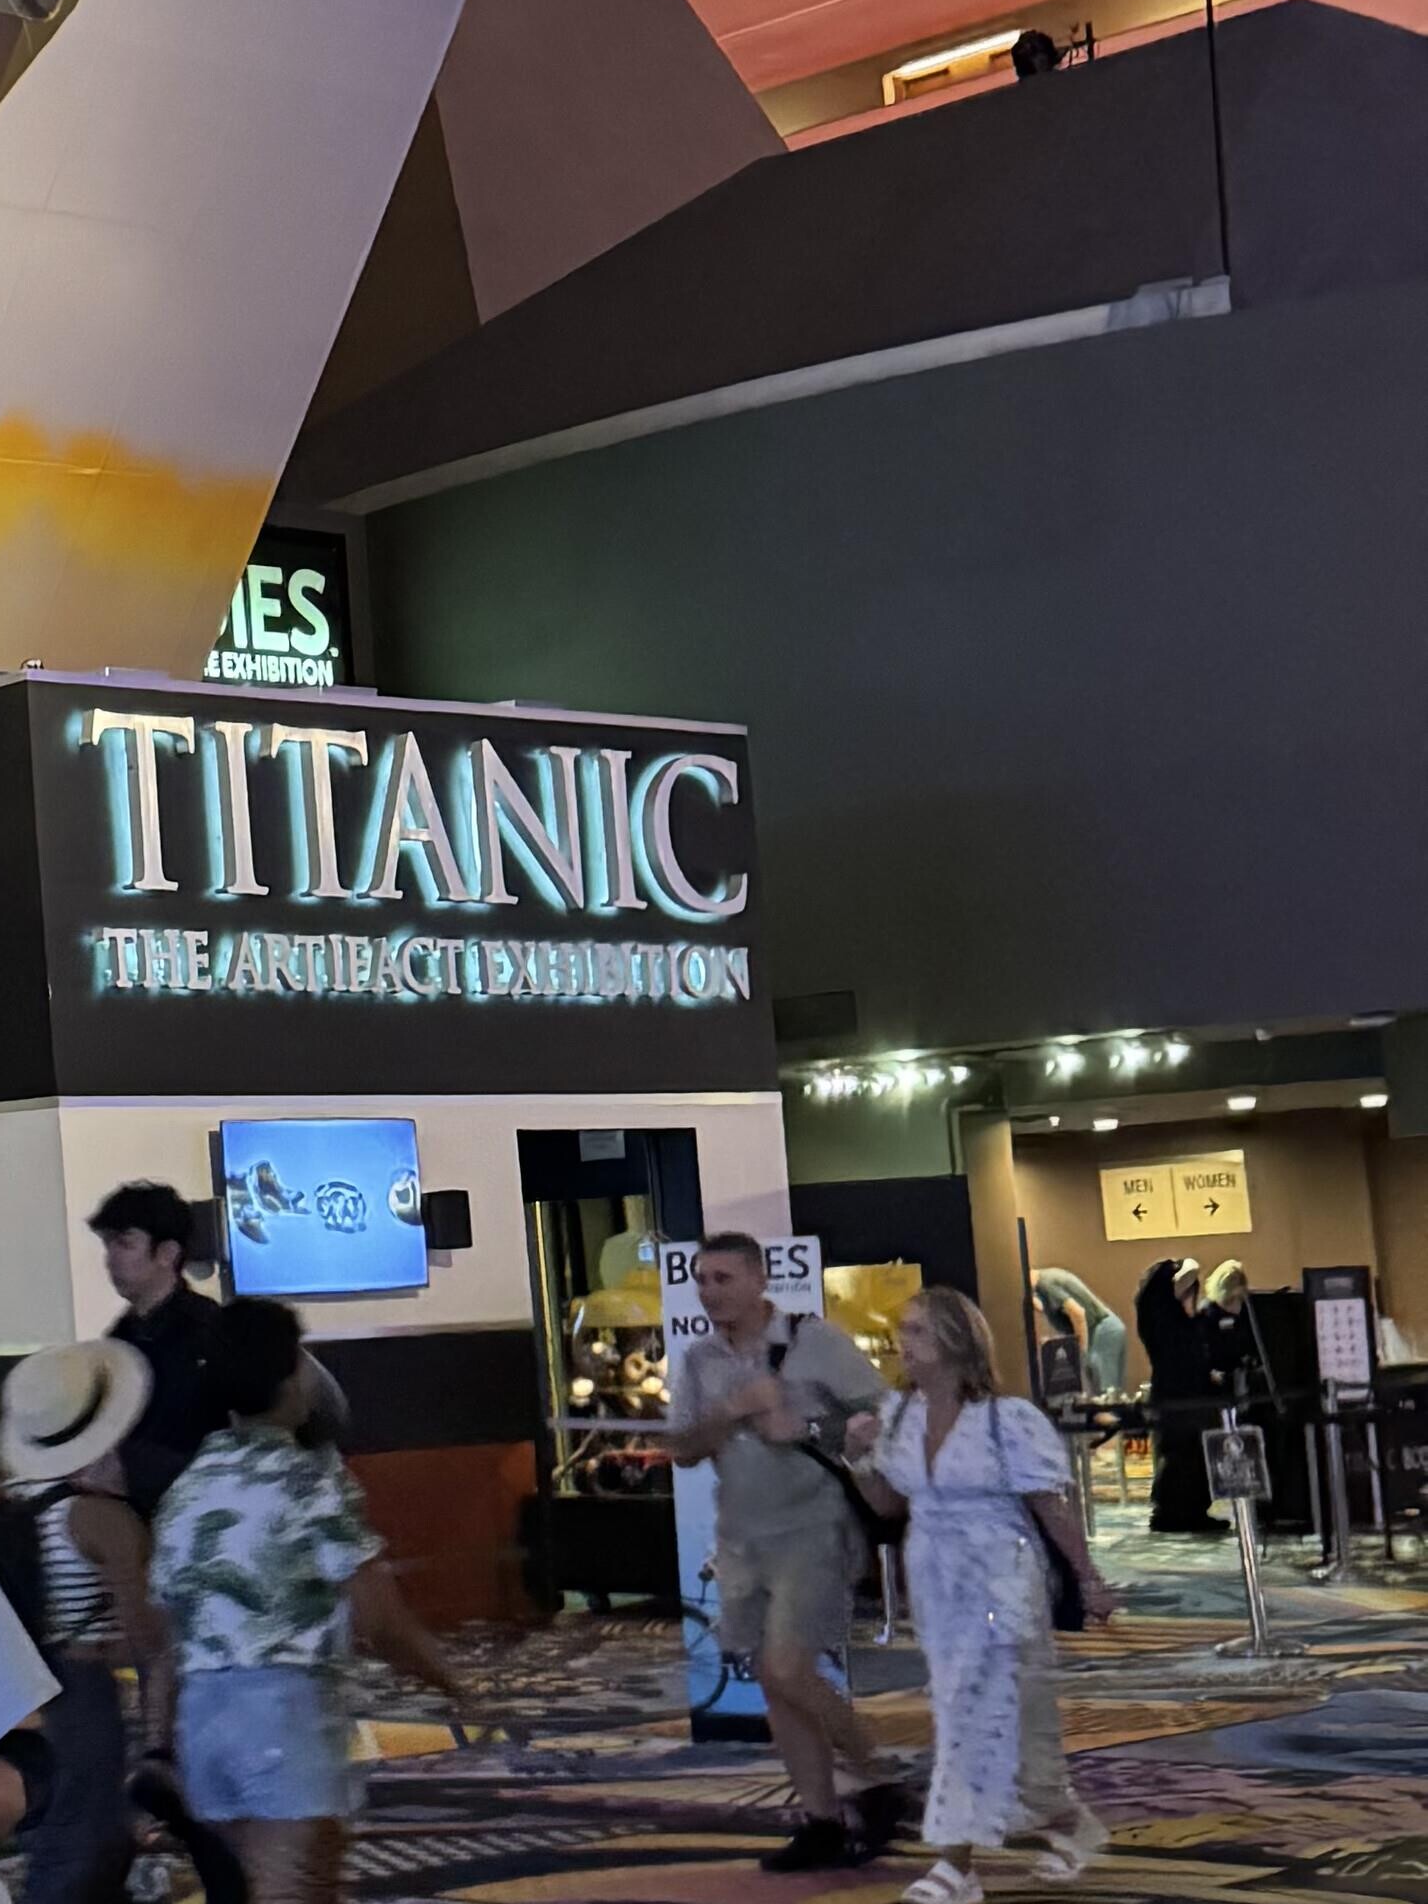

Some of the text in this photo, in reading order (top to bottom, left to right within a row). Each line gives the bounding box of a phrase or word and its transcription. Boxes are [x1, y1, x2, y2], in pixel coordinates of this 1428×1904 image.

[221, 651, 334, 687] EXHIBITION
[81, 707, 748, 915] TITANIC
[101, 927, 751, 1001] THE ARTIFACT EXHIBITION
[1123, 1178, 1154, 1195] MEN
[1183, 1173, 1237, 1191] WOMEN
